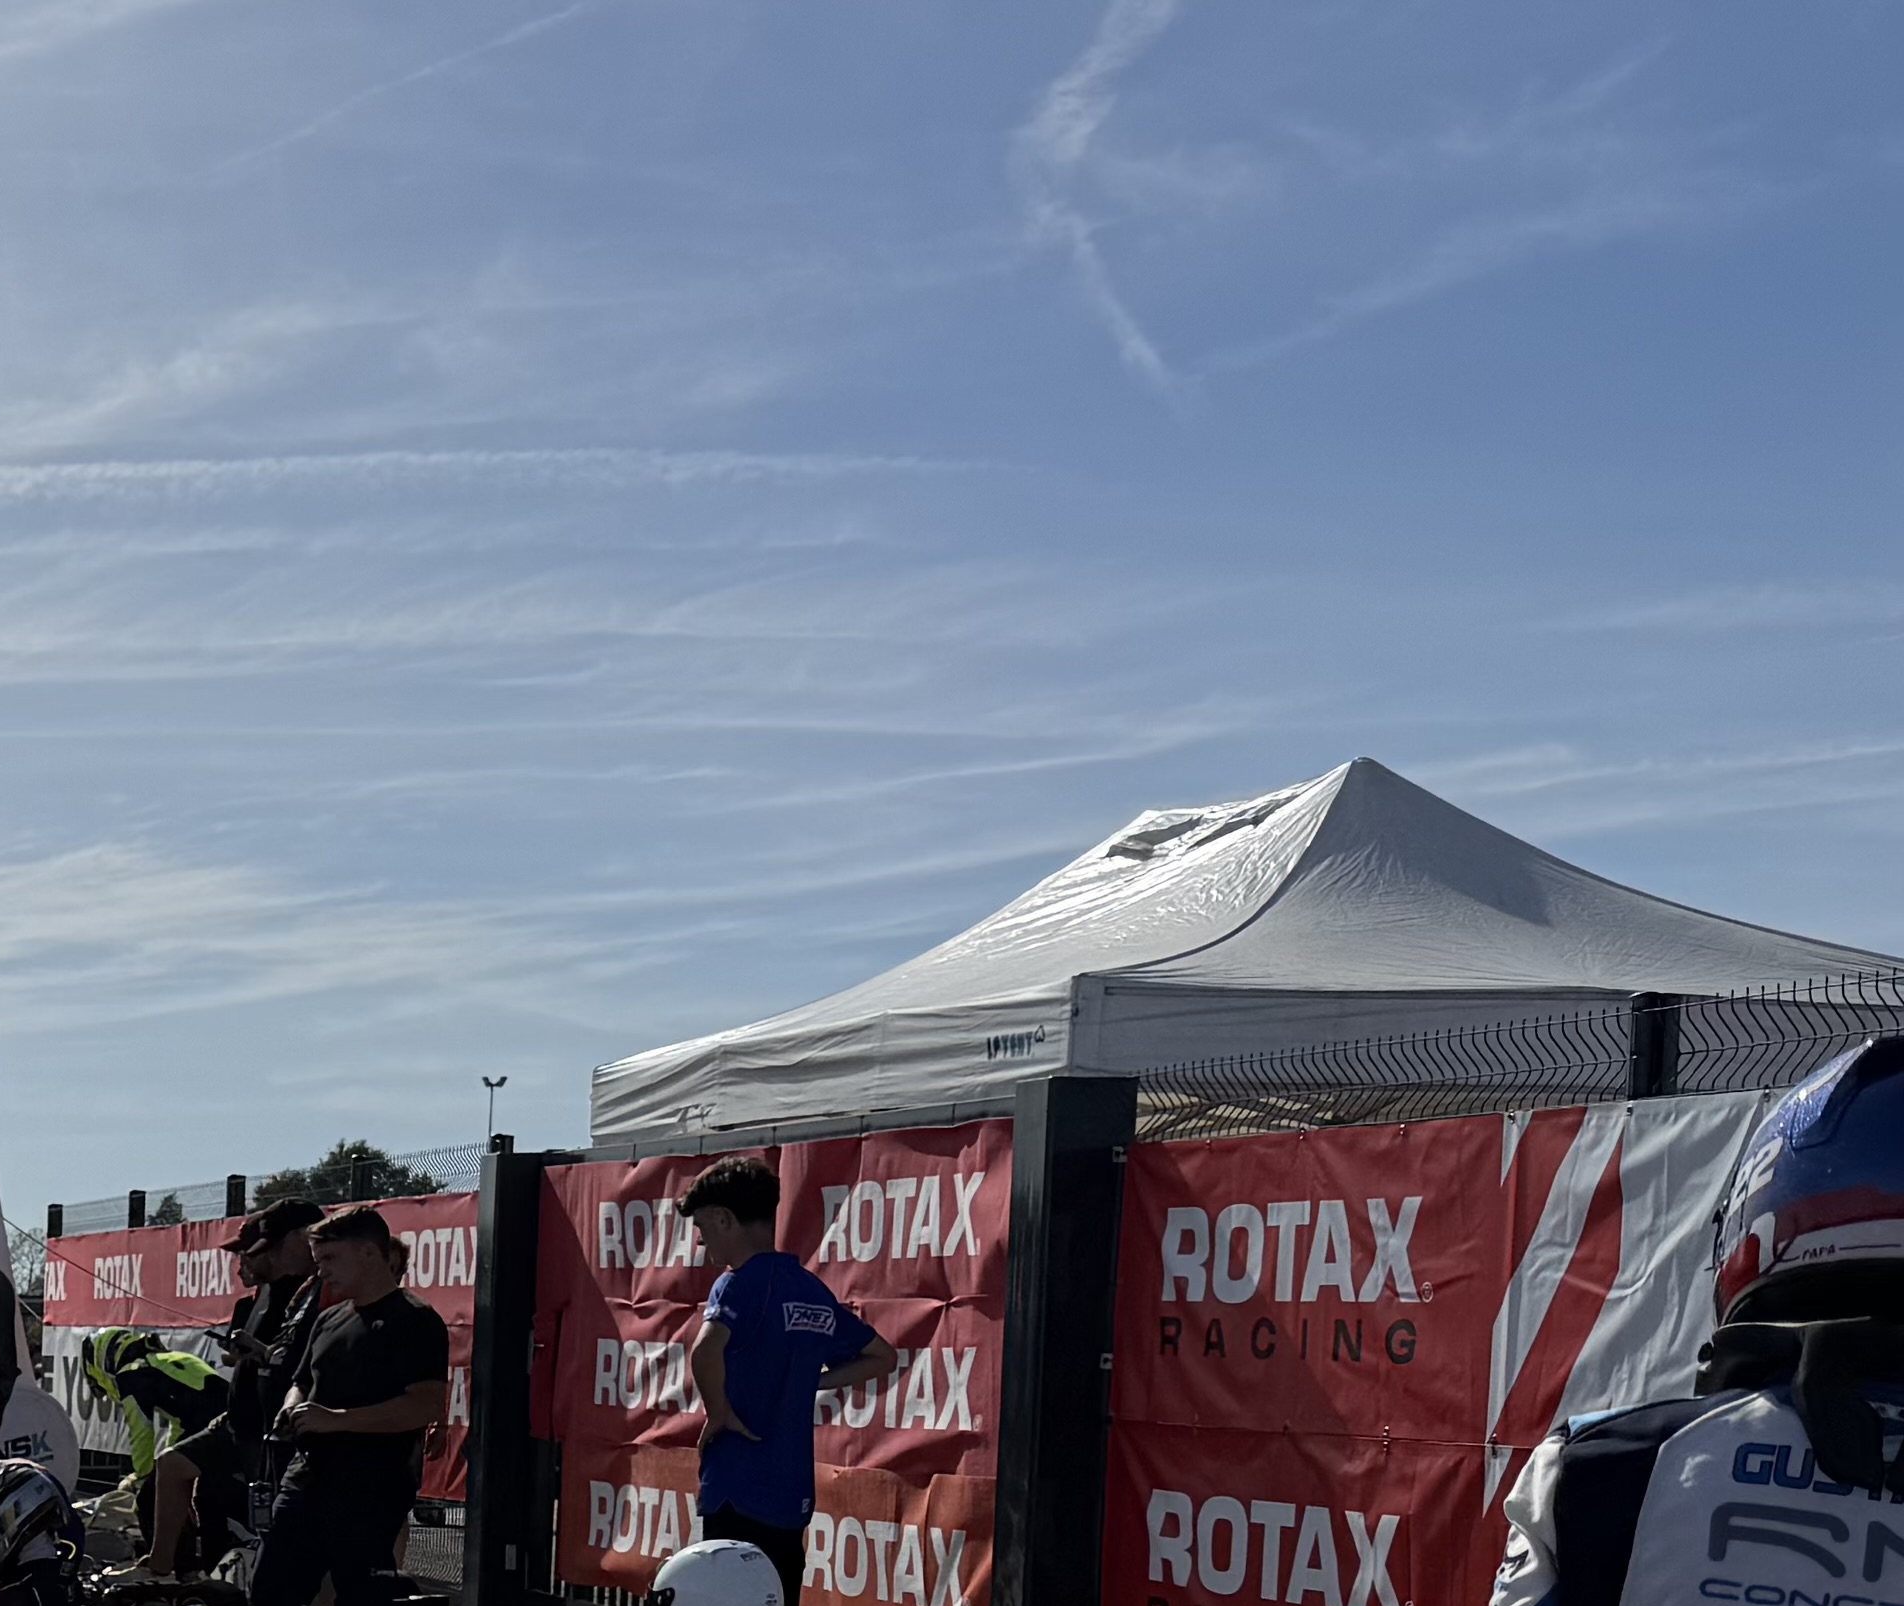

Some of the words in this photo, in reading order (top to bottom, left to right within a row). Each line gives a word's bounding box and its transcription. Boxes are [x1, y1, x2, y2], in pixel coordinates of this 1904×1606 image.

[598, 1199, 707, 1269] ROTA
[819, 1171, 985, 1265] ROTAX
[1159, 1196, 1425, 1304] ROTAX
[93, 1253, 143, 1300] ROTAX
[175, 1247, 234, 1299] ROTAX
[594, 1337, 706, 1413] ROTA
[1158, 1316, 1418, 1367] RACING
